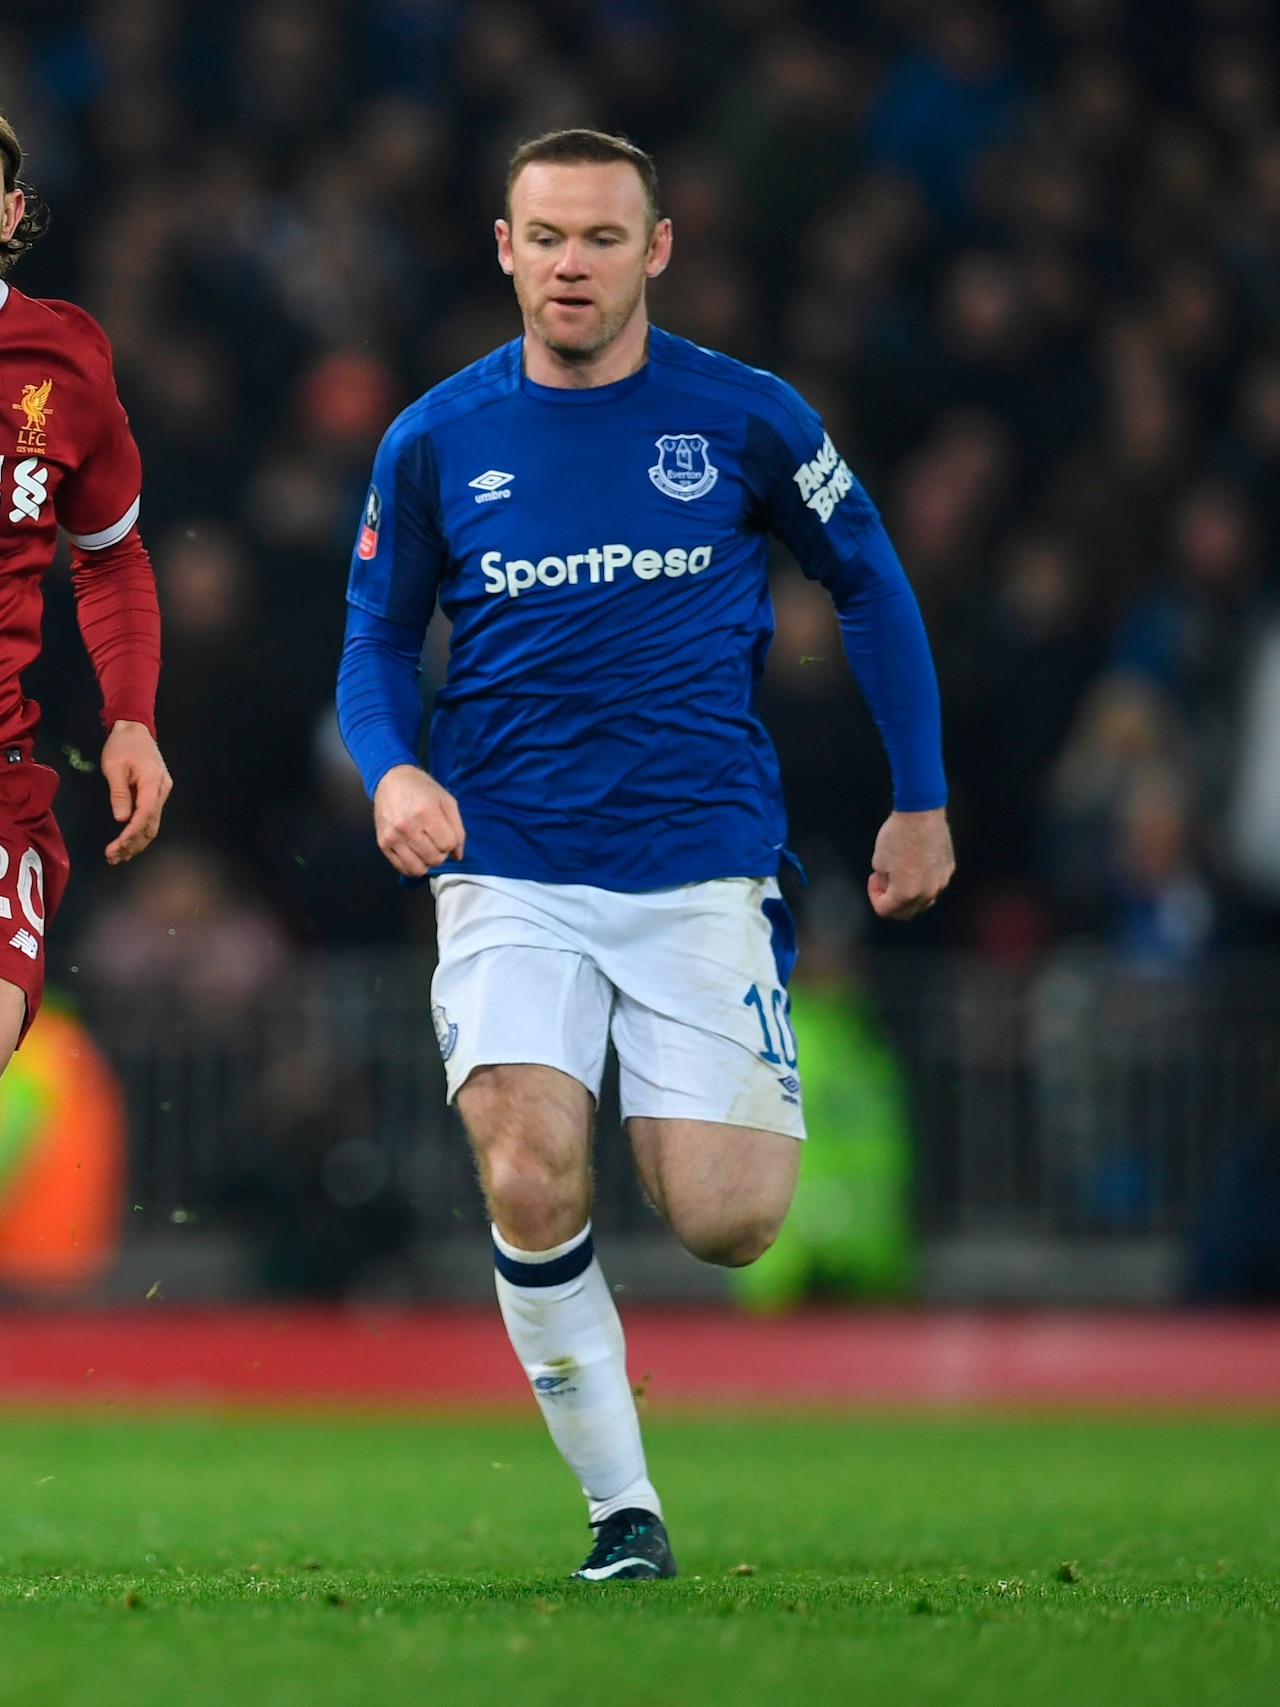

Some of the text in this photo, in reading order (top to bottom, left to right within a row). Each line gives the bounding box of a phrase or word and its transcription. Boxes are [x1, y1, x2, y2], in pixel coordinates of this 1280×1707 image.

[666, 469, 702, 479] Everton
[792, 429, 839, 502] ANG
[806, 459, 853, 524] BIR
[474, 489, 511, 504] umbro
[480, 544, 713, 597] SportPesa
[743, 984, 798, 1069] 10
